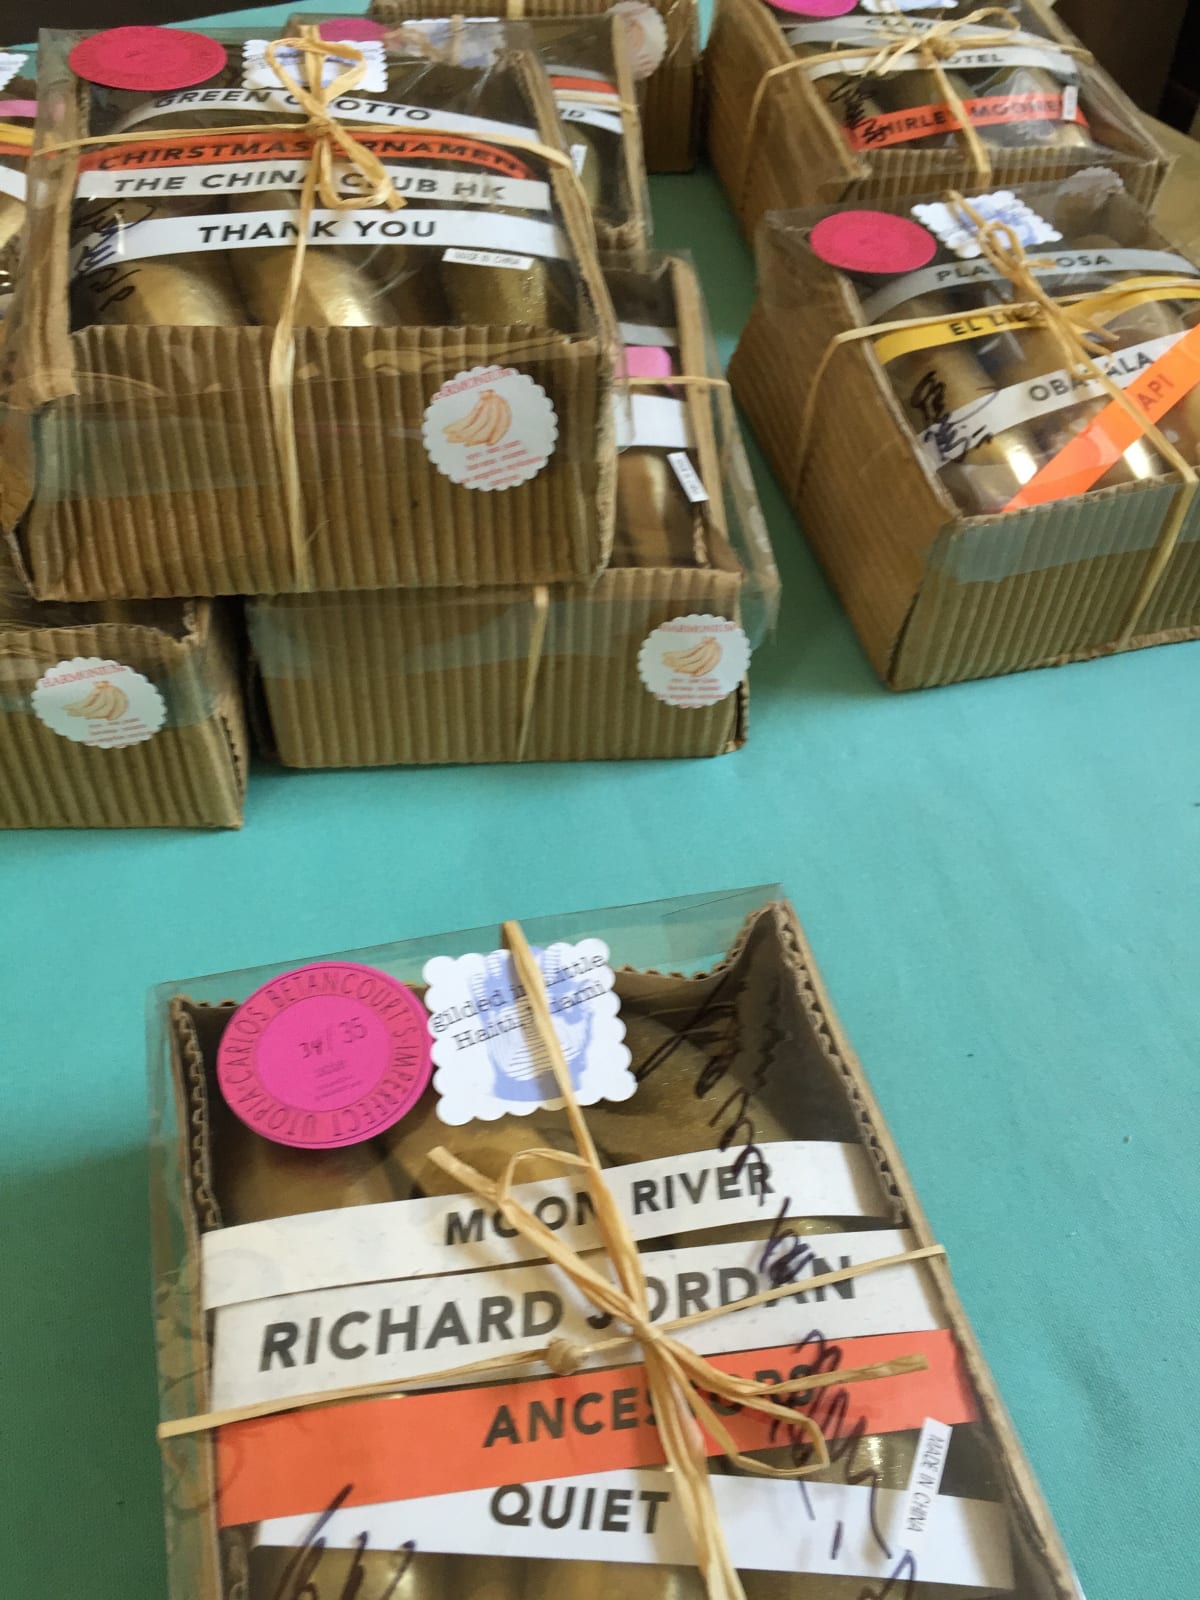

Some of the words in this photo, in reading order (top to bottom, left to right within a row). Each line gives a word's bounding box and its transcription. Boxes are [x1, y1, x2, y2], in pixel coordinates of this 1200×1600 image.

[154, 90, 271, 109] GREEN
[284, 95, 432, 122] GOTTO
[98, 139, 313, 170] CHIRSTMAS
[114, 175, 187, 193] THE
[340, 172, 439, 194] CUB
[452, 180, 509, 201] HK
[198, 220, 339, 244] THANK
[354, 220, 437, 238] YOU
[948, 320, 984, 336] EL
[1028, 350, 1155, 402] OBAALA
[430, 988, 507, 1034] gilded
[545, 954, 606, 987] ittle
[549, 980, 609, 1015] iami
[224, 1005, 271, 1085] CARLOS
[631, 1160, 776, 1216] RIVER
[258, 1291, 565, 1373] RICHARD
[482, 1363, 816, 1448] ANCEORS
[921, 1433, 946, 1473] MADE
[916, 1472, 937, 1490] IN
[489, 1483, 671, 1535] QUIET
[906, 1491, 931, 1533] CHINA
